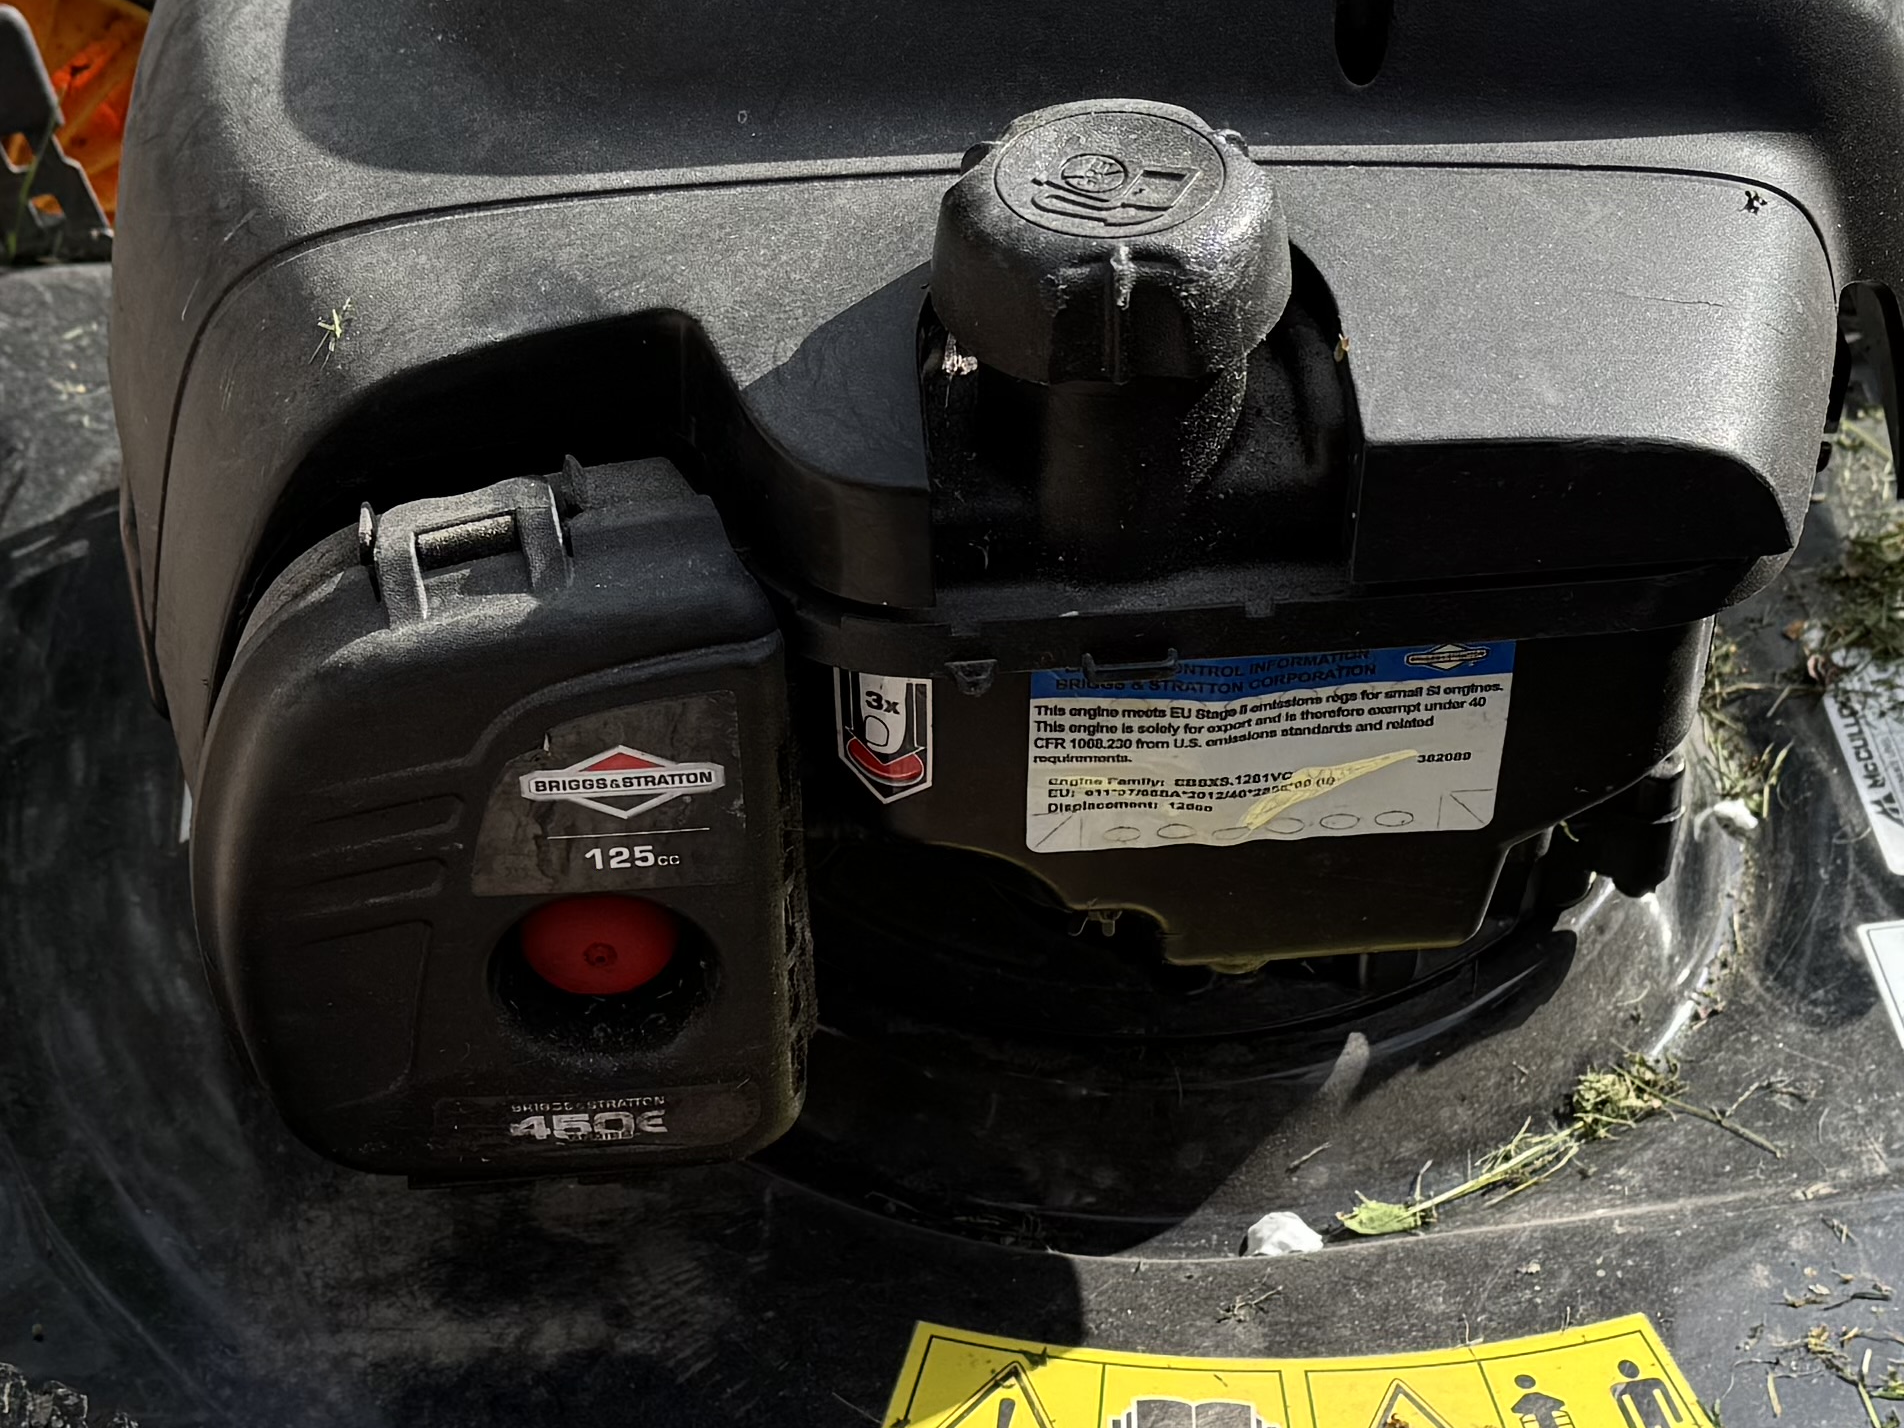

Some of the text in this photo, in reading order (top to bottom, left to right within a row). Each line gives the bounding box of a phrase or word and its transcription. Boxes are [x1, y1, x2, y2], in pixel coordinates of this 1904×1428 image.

[1149, 679, 1243, 694] STRATTON
[1248, 664, 1376, 690] CORPORATION
[865, 690, 900, 715] 3x
[1034, 704, 1066, 716] This
[1069, 705, 1119, 720] engine
[1122, 707, 1167, 718] meets
[1170, 706, 1192, 719] EU
[1195, 708, 1237, 721] Stage
[1249, 696, 1322, 713] emissions
[1326, 692, 1357, 705] regs
[1361, 689, 1382, 701] for
[1384, 686, 1423, 699] small
[1034, 696, 1487, 737] This engine is solely for export and is therefore exempt under 40
[1034, 737, 1066, 749] CFR
[1136, 738, 1170, 749] from
[1174, 738, 1202, 748] U.S.
[1205, 730, 1278, 747] emissions
[1281, 722, 1353, 736] standards
[1355, 720, 1383, 732] and
[1386, 715, 1435, 730] related
[1033, 754, 1132, 765] requirements.
[535, 771, 713, 792] BRIGGS&STRATTON
[1048, 777, 1103, 786] Engine
[1108, 777, 1165, 787] Family:
